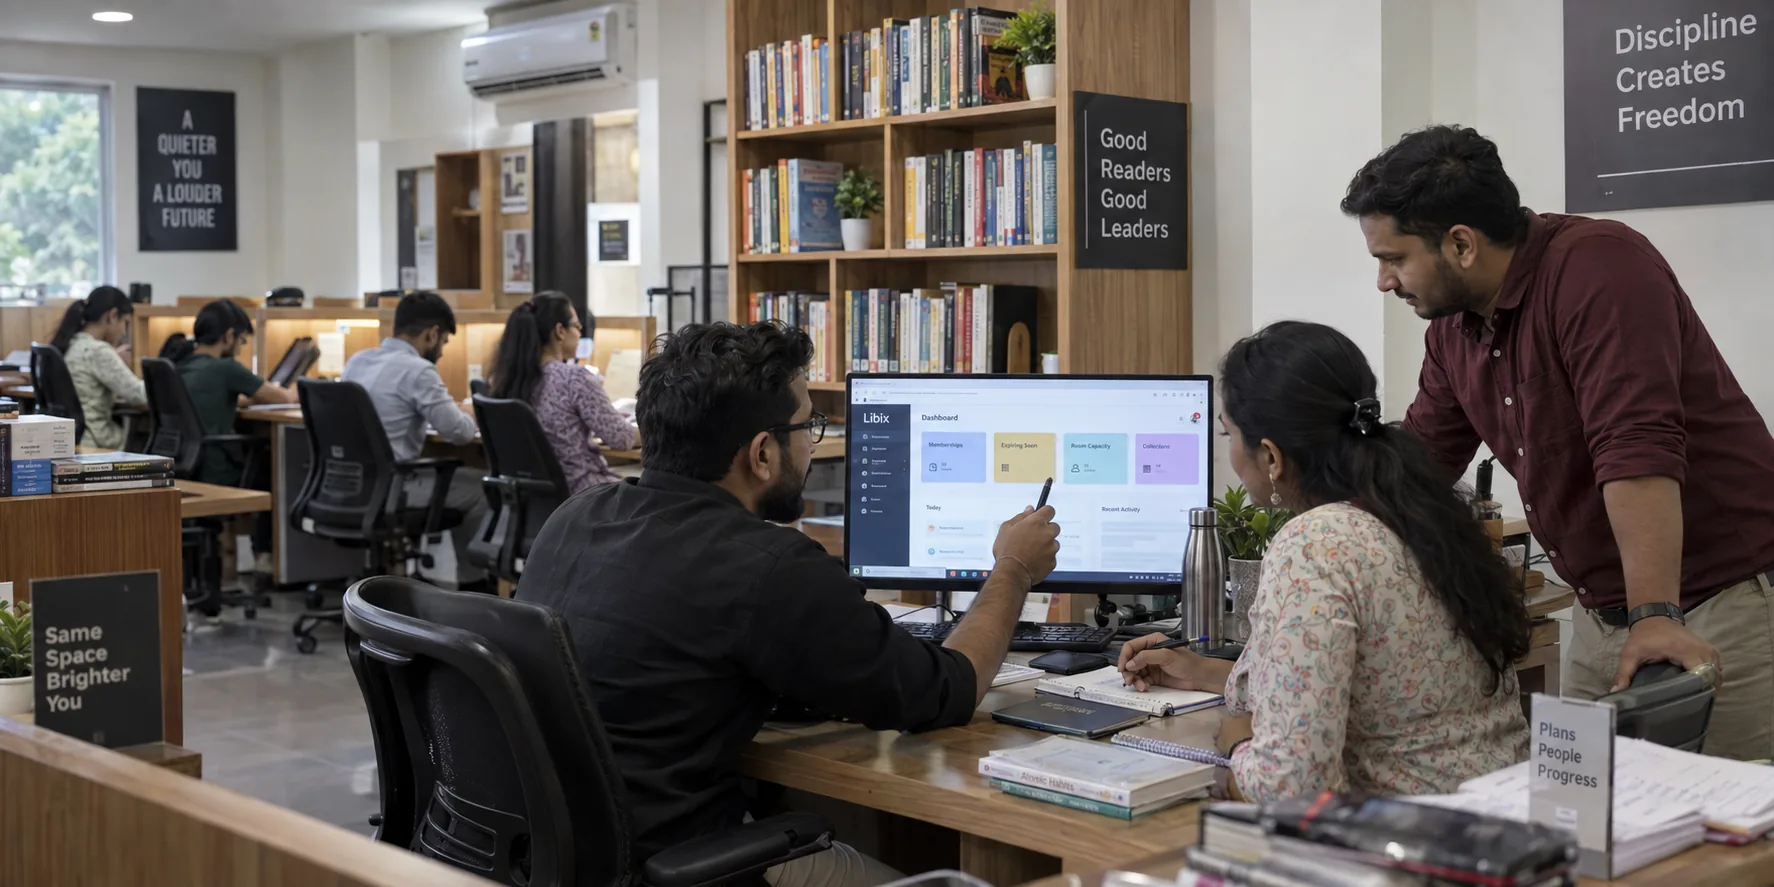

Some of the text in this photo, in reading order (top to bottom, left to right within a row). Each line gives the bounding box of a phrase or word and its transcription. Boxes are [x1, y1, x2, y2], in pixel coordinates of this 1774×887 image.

[1616, 12, 1757, 54] Discipline
[1616, 60, 1726, 92] Creates
[182, 109, 193, 130] A
[1618, 97, 1745, 132] Freedom
[158, 134, 217, 156] QUIETER
[1100, 127, 1147, 151] Good
[172, 159, 203, 180] YOU
[1101, 157, 1171, 183] Readers
[153, 183, 222, 204] A LOUDER
[1101, 187, 1147, 211] Good
[162, 207, 215, 228] FUTURE
[1101, 217, 1169, 240] Leaders
[863, 412, 890, 424] Libix
[921, 414, 959, 422] Dashboard
[1001, 442, 1023, 450] Expiring
[1087, 443, 1112, 451] Capacity
[926, 504, 942, 512] Today
[1121, 506, 1141, 514] Activity
[45, 625, 103, 645] Same
[45, 647, 108, 670] Space
[46, 667, 131, 691] Brighter
[46, 695, 82, 713] You
[1539, 721, 1576, 742] Plans
[1538, 742, 1582, 764] People
[1538, 763, 1598, 788] Progress
